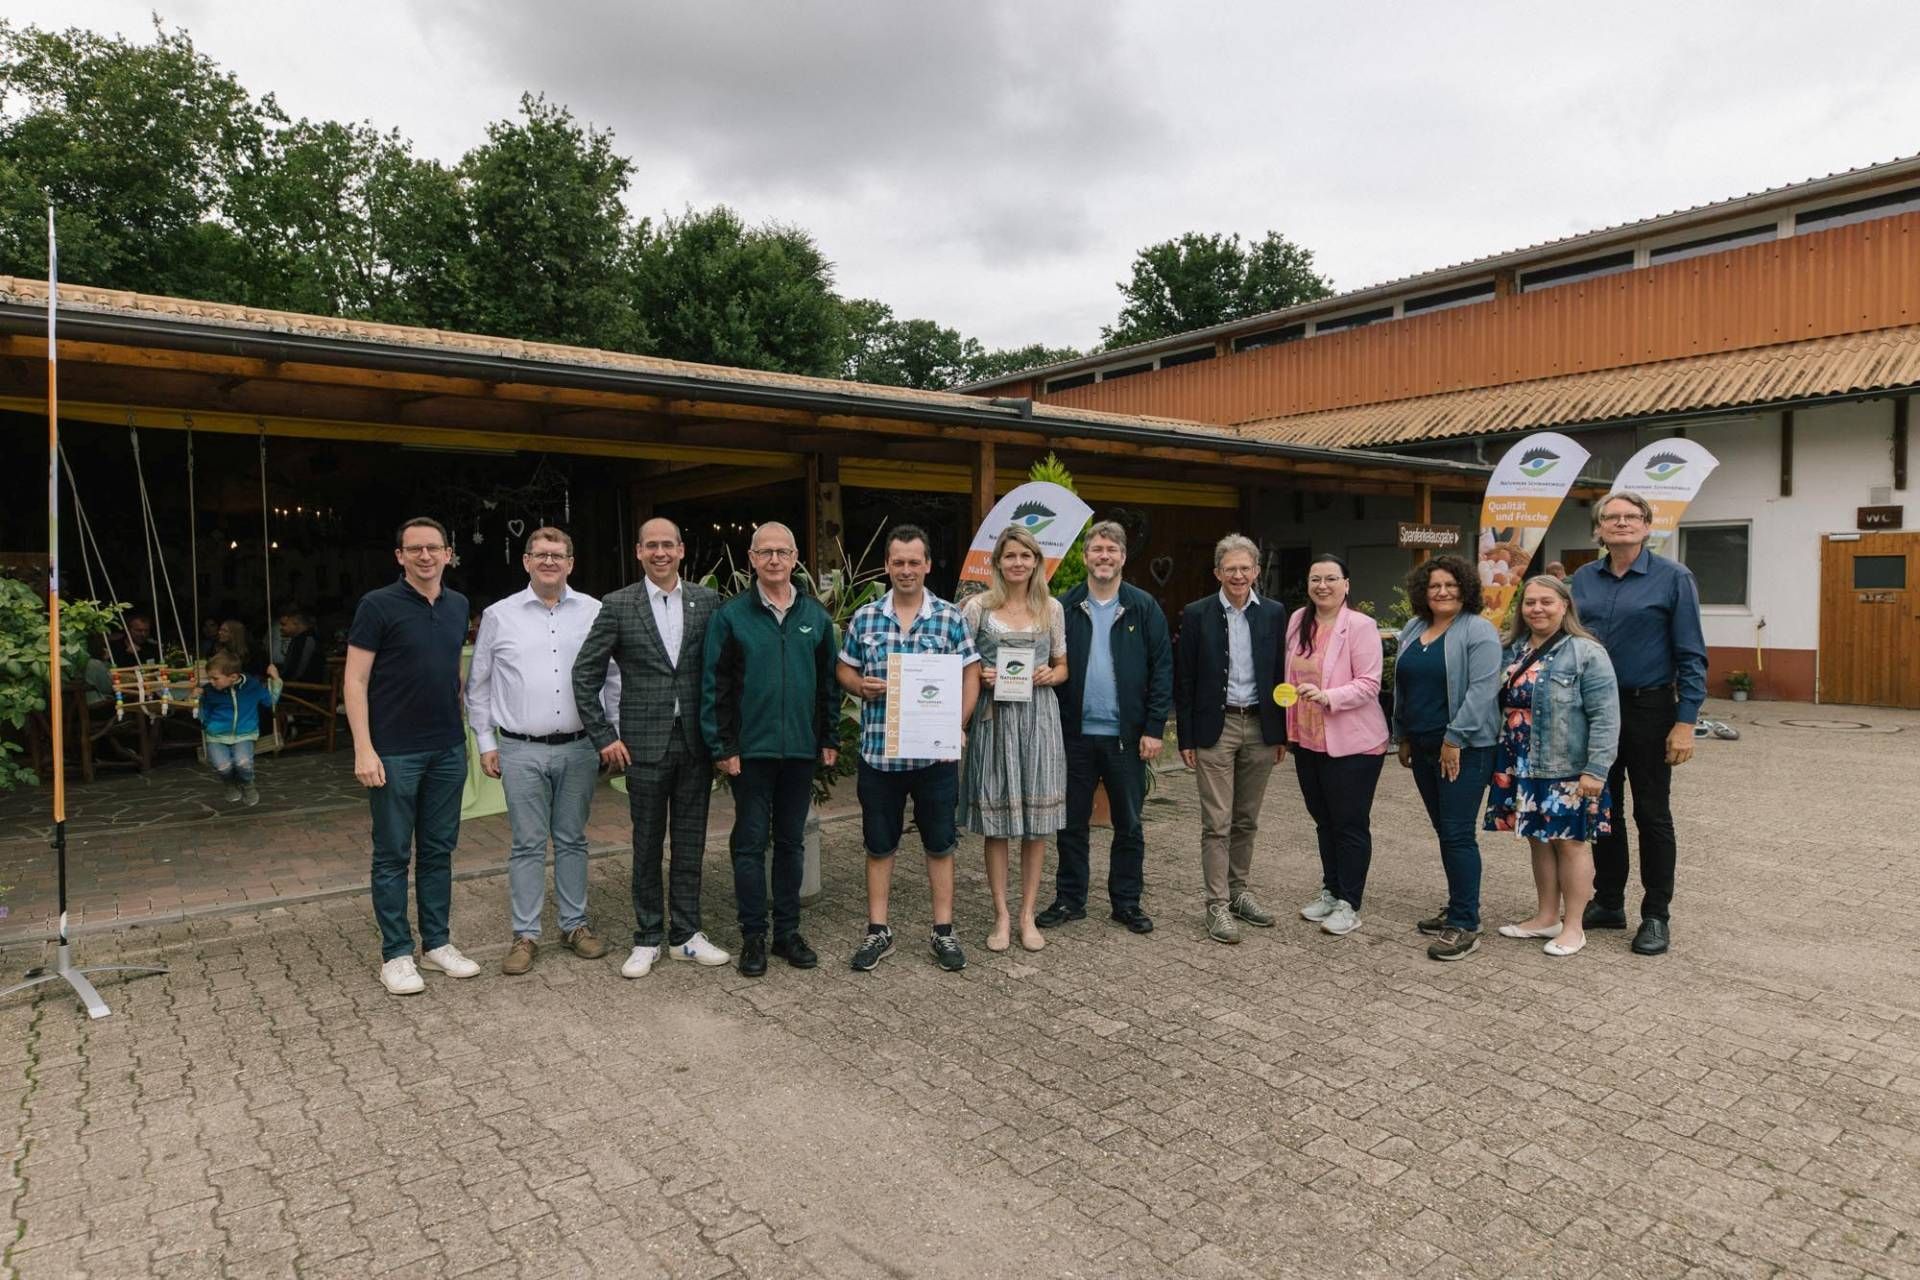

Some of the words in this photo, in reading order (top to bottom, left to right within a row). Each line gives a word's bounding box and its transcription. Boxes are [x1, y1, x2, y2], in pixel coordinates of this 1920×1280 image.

[1488, 501, 1526, 512] Qualität
[1496, 513, 1513, 521] und
[1516, 512, 1549, 522] Frische
[1866, 514, 1891, 522] WC
[887, 656, 901, 753] URKUNDE
